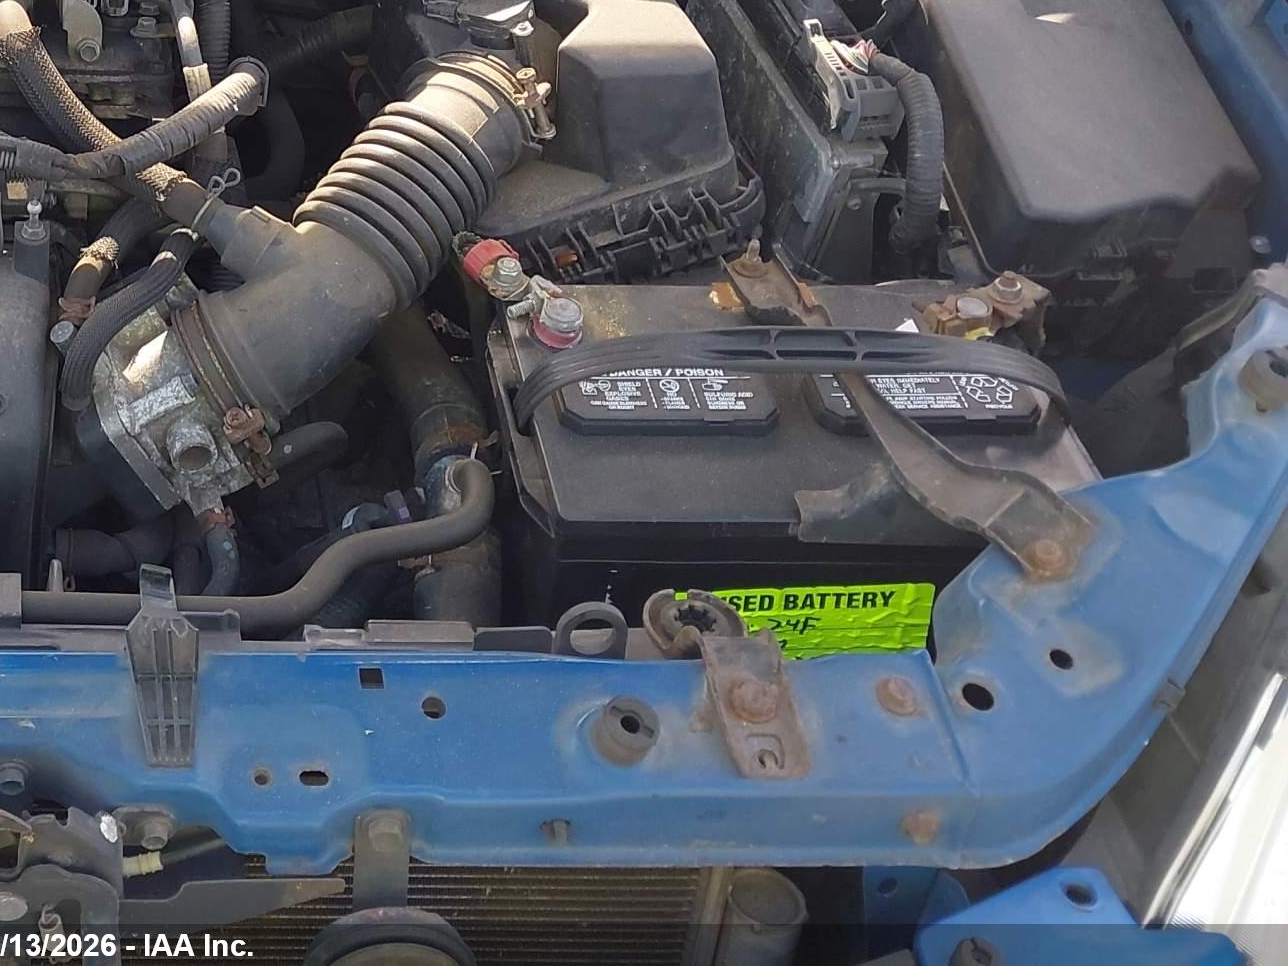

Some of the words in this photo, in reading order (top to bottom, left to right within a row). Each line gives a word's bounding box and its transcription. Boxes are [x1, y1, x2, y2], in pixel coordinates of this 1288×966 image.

[677, 368, 724, 376] POISON
[722, 593, 775, 613] SED
[783, 591, 897, 612] BATTERY
